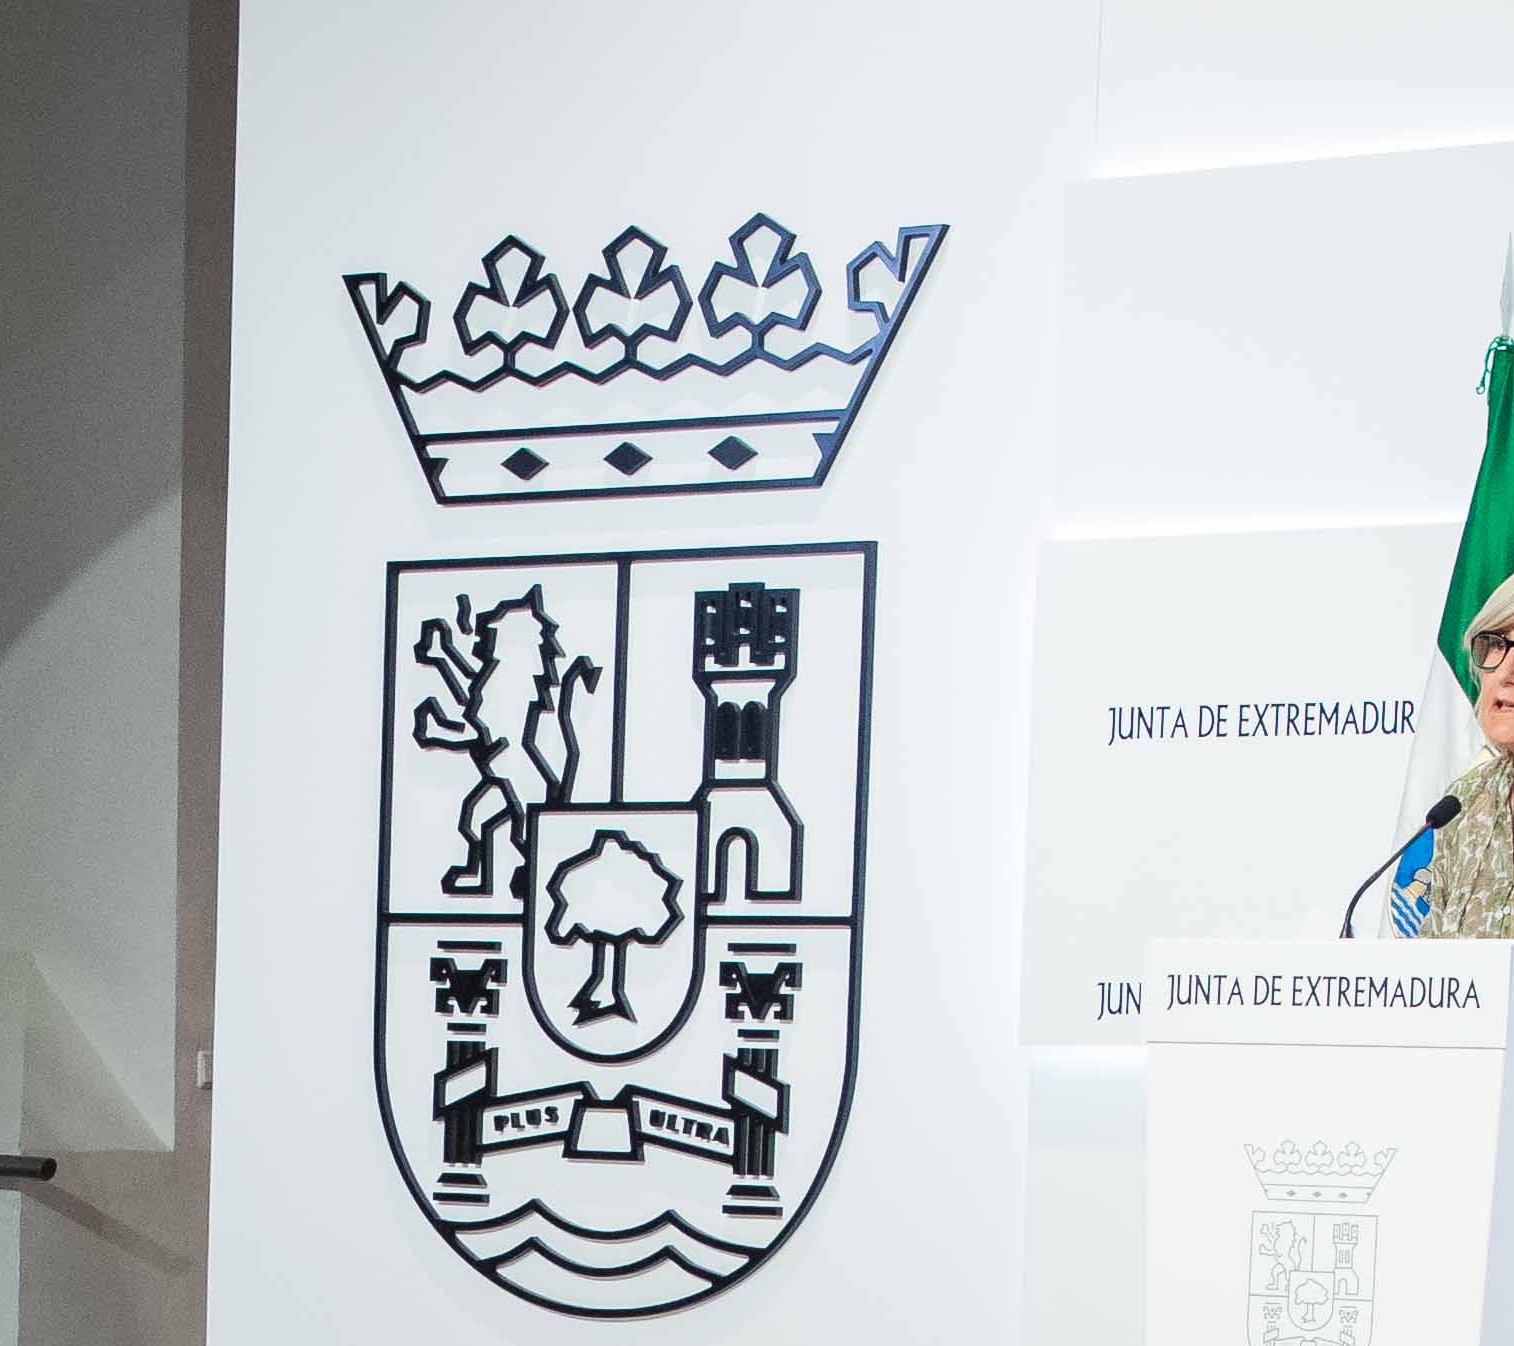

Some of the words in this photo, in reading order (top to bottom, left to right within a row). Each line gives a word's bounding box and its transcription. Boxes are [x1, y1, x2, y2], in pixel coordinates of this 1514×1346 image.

[1107, 706, 1189, 746] JUNTA
[1198, 704, 1229, 738] DE
[1238, 700, 1416, 736] EXTREMADUR
[1097, 982, 1142, 1021] JUN
[1167, 974, 1245, 1010] JUNTA
[1253, 975, 1283, 1006] DE
[1291, 975, 1481, 1009] EXTREMADURA
[493, 1105, 561, 1135] PLUS
[648, 1108, 733, 1147] ULTRA
